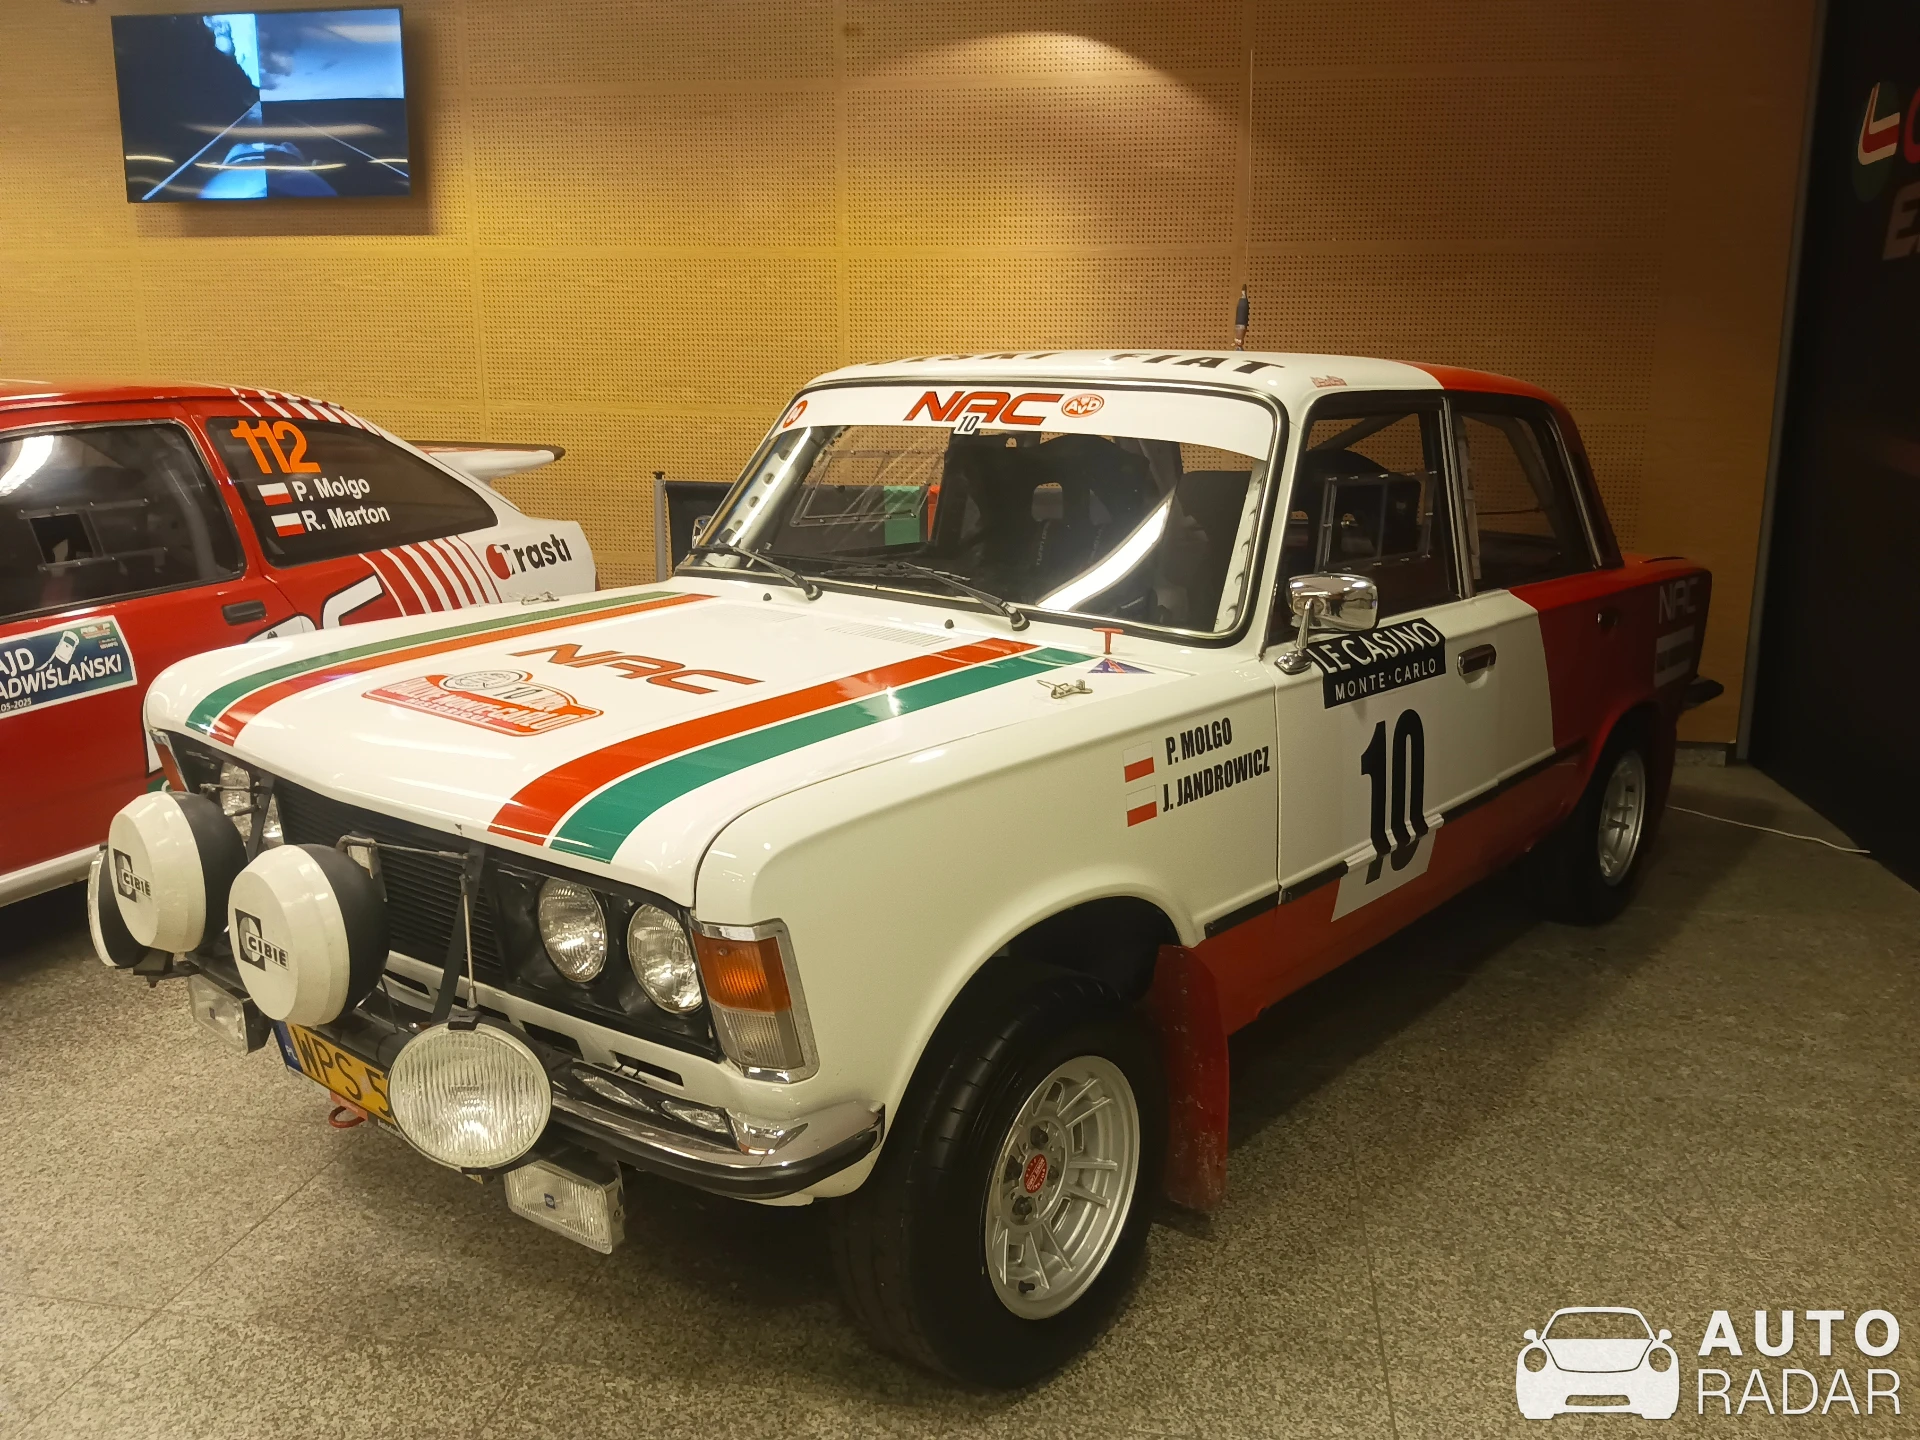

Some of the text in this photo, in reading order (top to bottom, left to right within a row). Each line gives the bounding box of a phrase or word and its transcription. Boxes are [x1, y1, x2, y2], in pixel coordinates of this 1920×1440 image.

[1102, 353, 1285, 374] FIAT
[903, 391, 1064, 426] NAC
[957, 415, 980, 432] 10
[230, 420, 322, 474] 112
[292, 475, 371, 502] P. Molgo
[301, 504, 391, 532] R. Marton
[506, 643, 766, 695] NAC
[1306, 622, 1441, 674] LE CASINO
[1165, 717, 1233, 766] P. MOLGO
[1162, 746, 1270, 813] J. JANDROWICZ
[1361, 709, 1429, 885] 10
[290, 1025, 363, 1101] WPS
